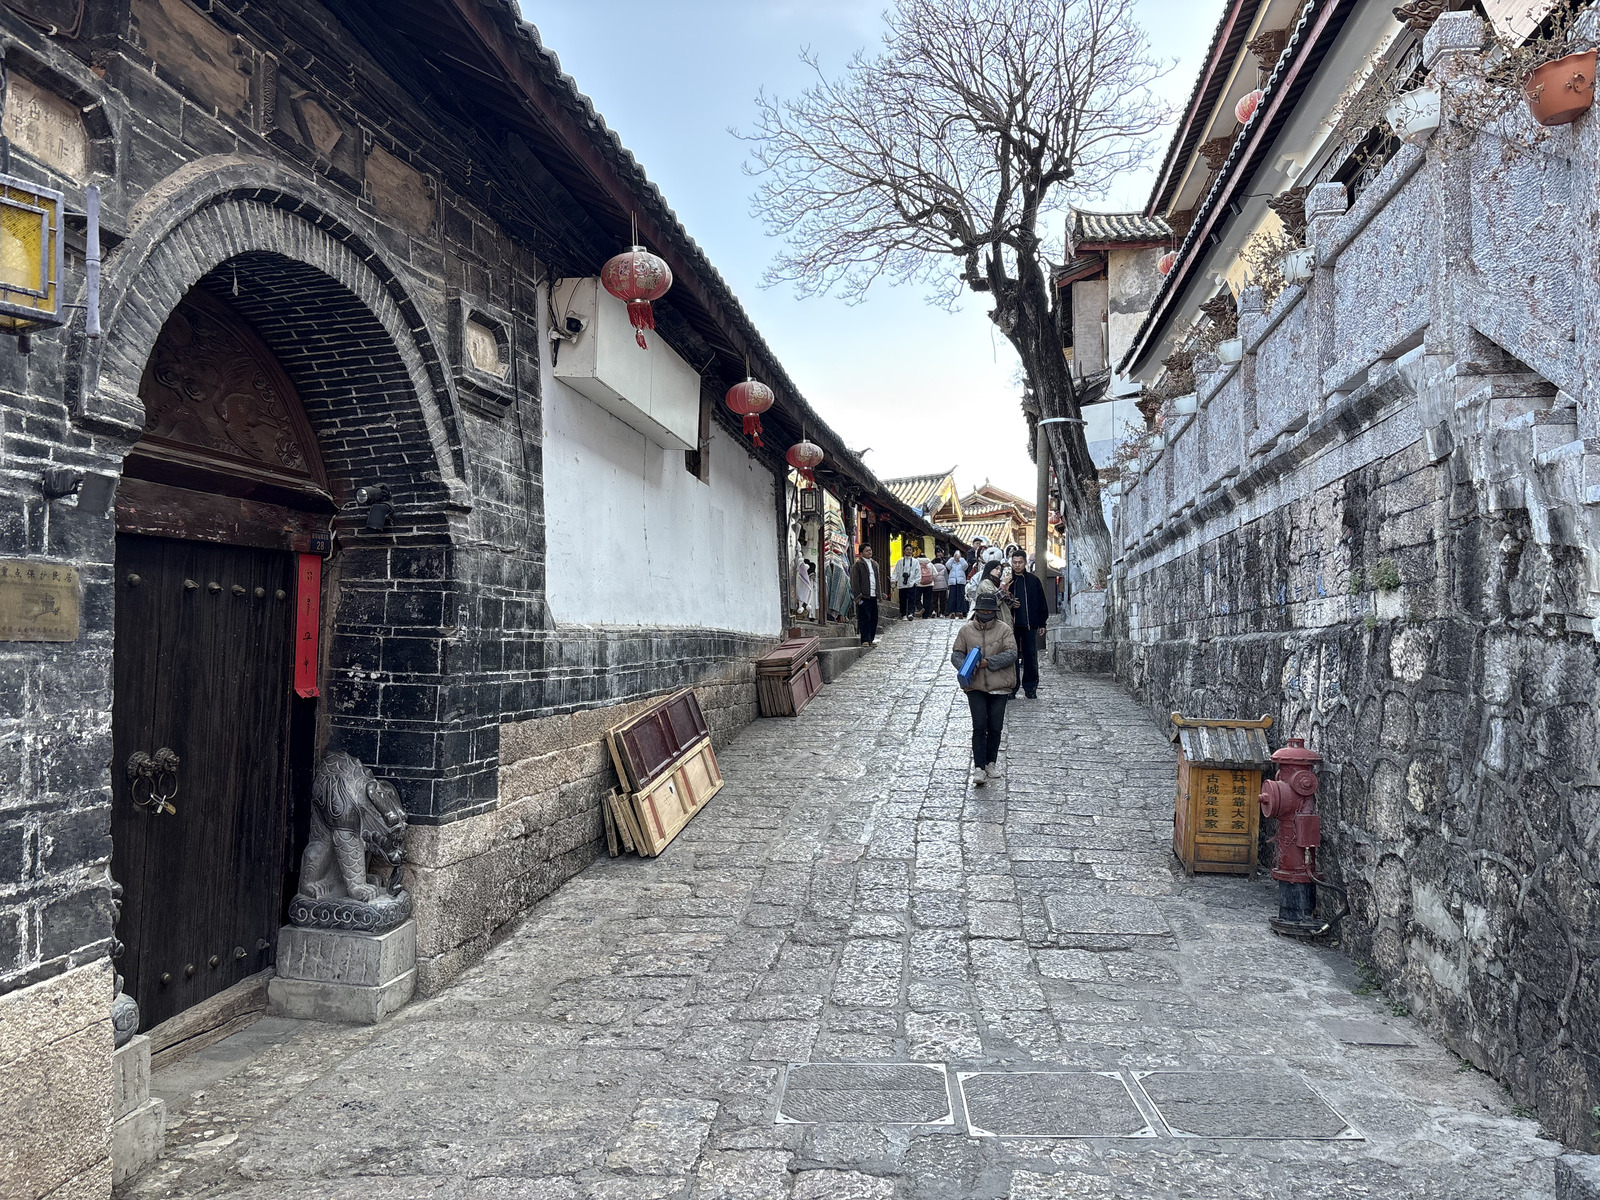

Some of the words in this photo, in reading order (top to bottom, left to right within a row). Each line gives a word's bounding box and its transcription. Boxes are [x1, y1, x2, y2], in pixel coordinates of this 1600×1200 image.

[316, 540, 325, 551] 28
[1, 565, 73, 583] 重点保护民居
[1205, 773, 1220, 829] 古城是我家
[1232, 774, 1247, 830] 环境靠大家
